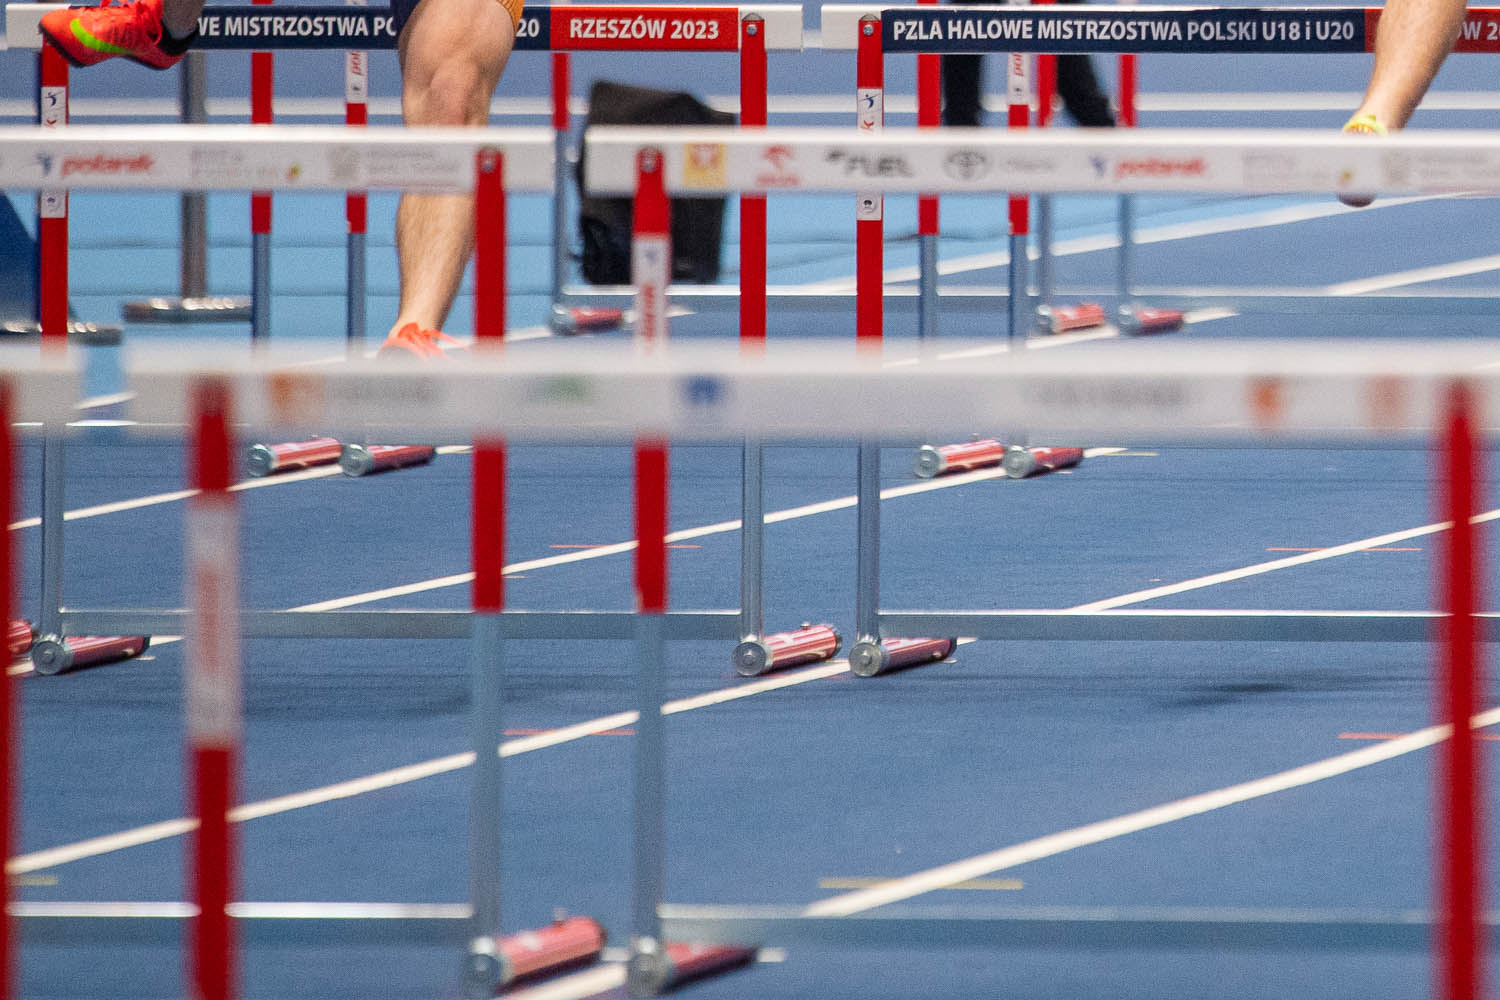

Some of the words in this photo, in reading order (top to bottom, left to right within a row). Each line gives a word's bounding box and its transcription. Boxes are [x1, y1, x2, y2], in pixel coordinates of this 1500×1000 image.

[225, 16, 369, 37] MISTRZOSTWA
[515, 18, 540, 37] 20
[570, 15, 666, 40] RZESZÓW
[670, 20, 719, 39] 2023
[893, 20, 944, 41] PZLA
[947, 19, 1033, 40] HALOWE
[1037, 20, 1182, 41] MISTRZOSTWA
[1187, 21, 1257, 41] POLSKI
[1262, 21, 1301, 41] U18
[1304, 20, 1311, 41] i
[1315, 21, 1355, 41] U20
